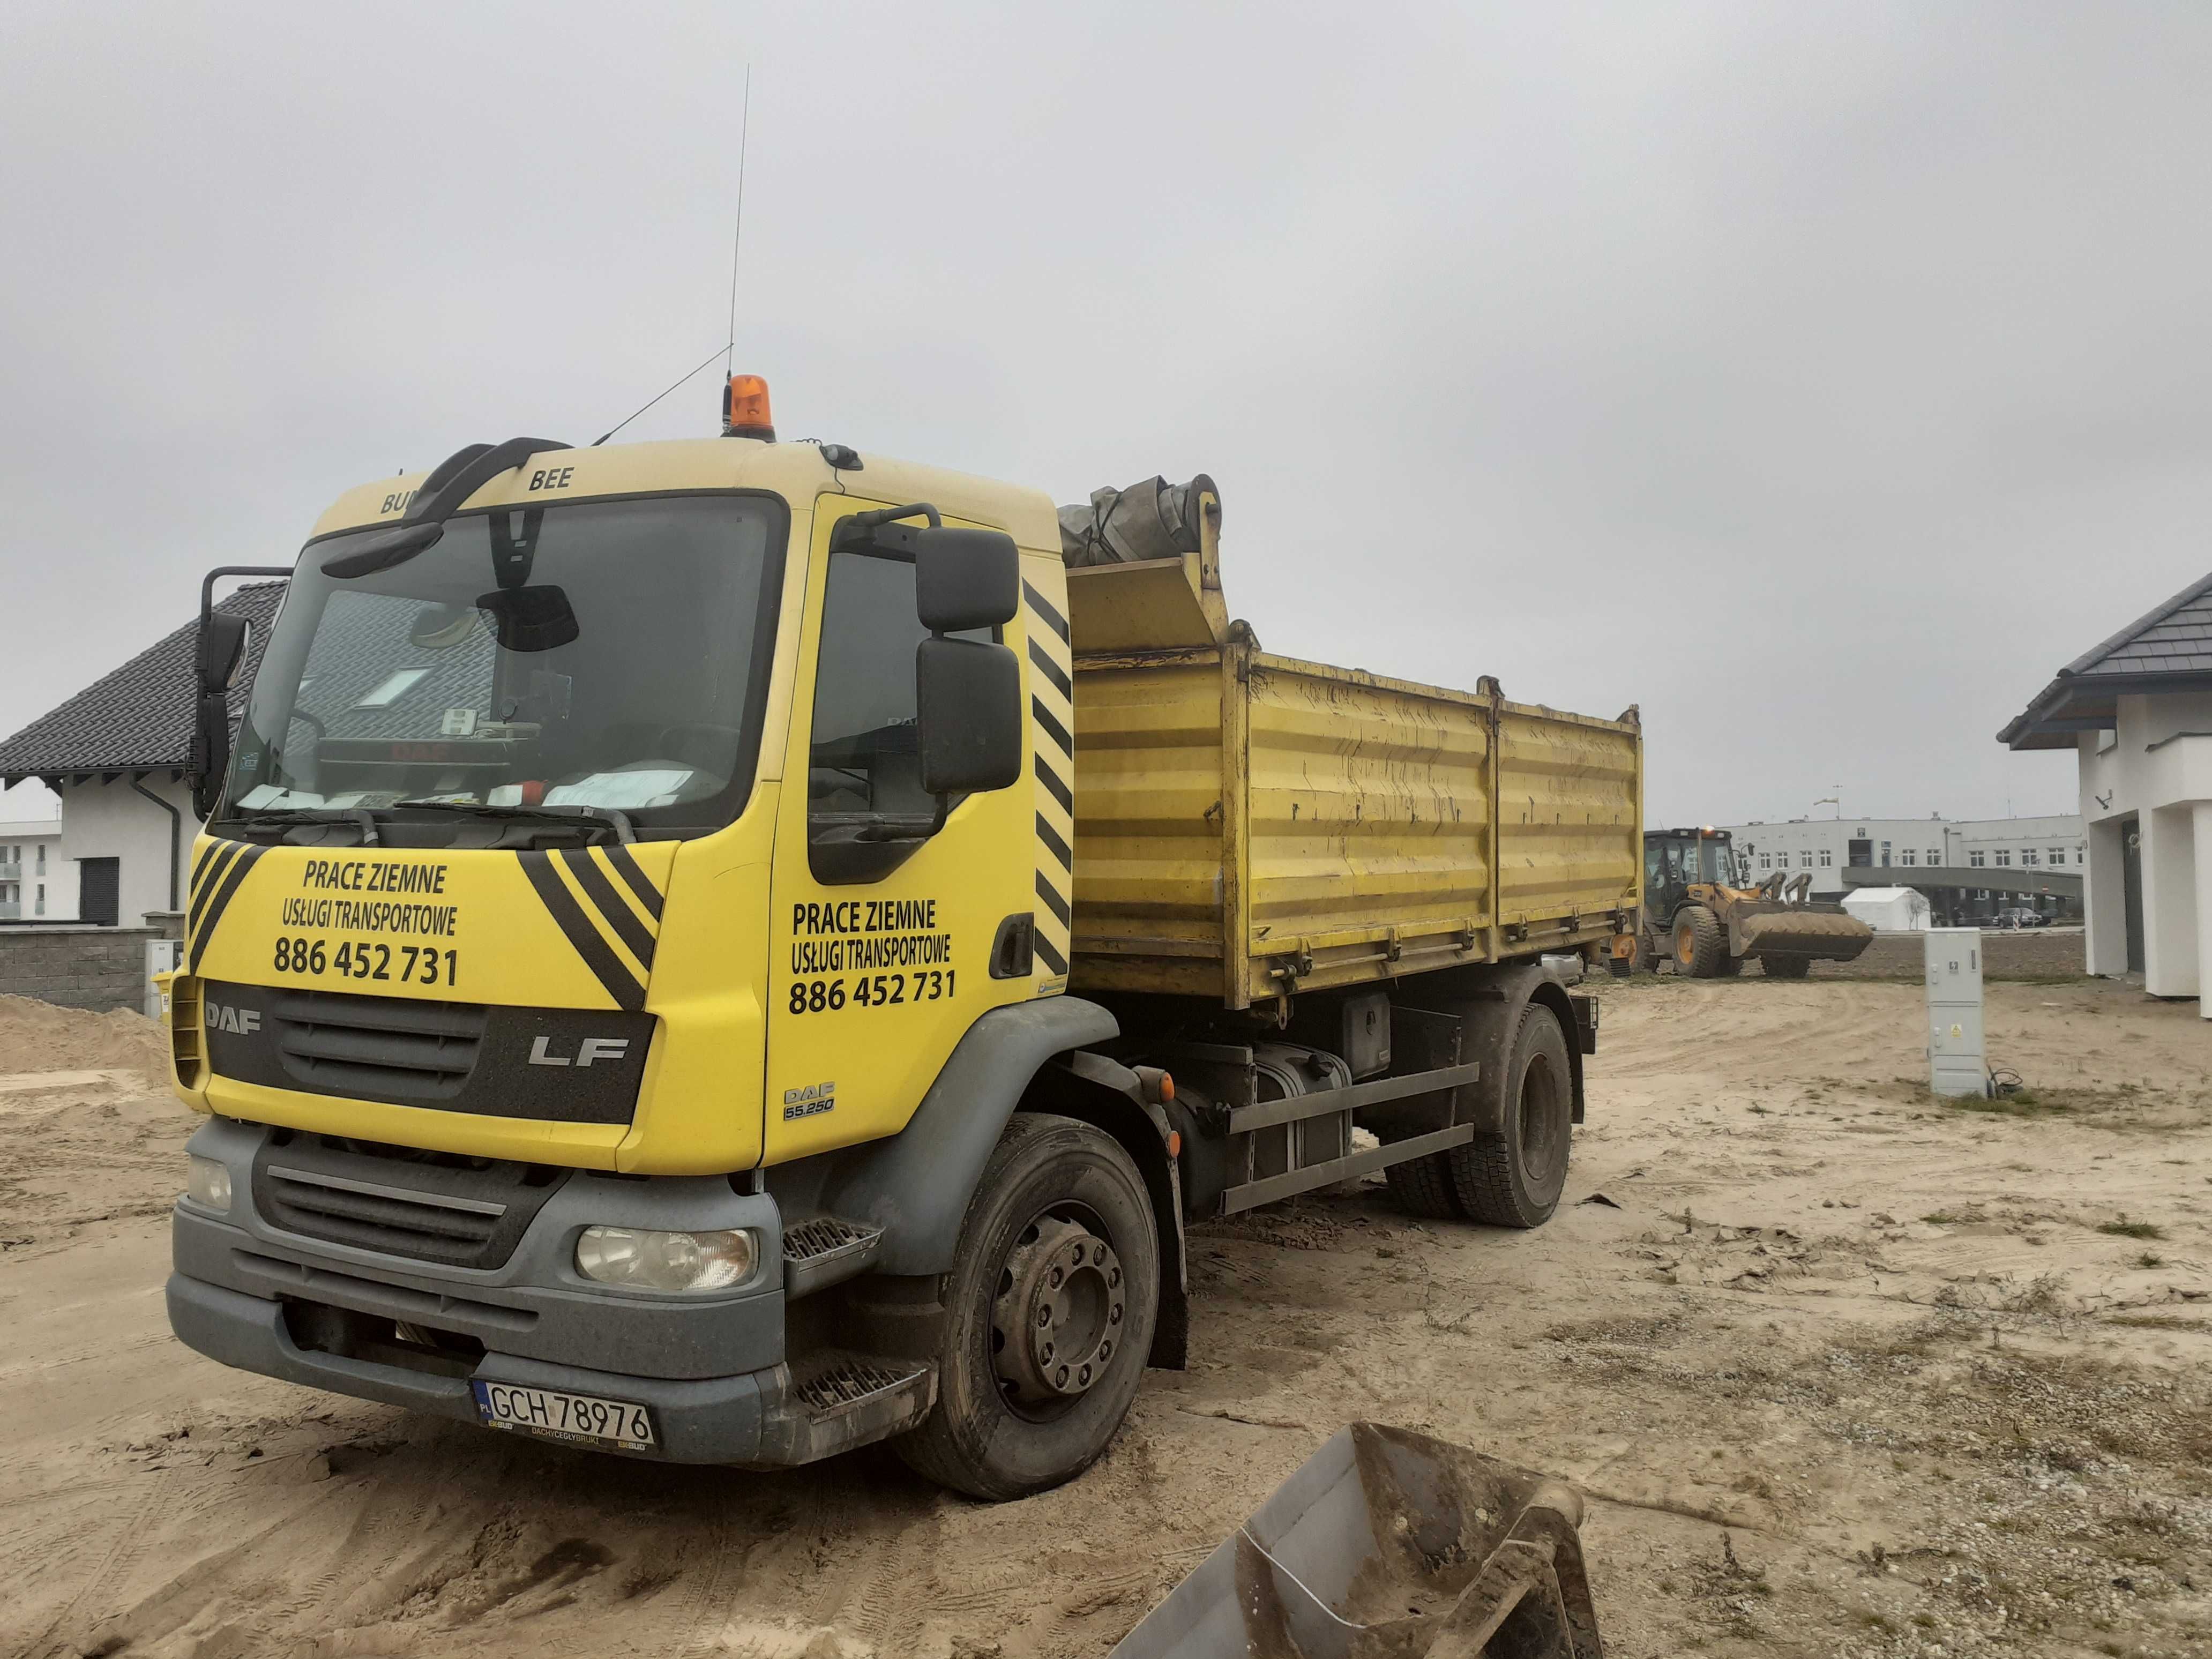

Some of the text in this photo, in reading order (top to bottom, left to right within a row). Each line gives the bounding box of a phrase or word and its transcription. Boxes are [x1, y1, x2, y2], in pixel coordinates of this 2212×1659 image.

[528, 467, 575, 491] BEE
[303, 860, 448, 894] PRACE ZIEMNE
[282, 898, 458, 936] USŁUGI TRANSPORTOWE
[793, 900, 936, 935] PRACE ZIEMNE
[274, 937, 458, 987] 886 452 731
[791, 934, 951, 975] USŁUGI TRANSPORTOWE
[789, 969, 955, 1015] 886 452 731
[205, 1001, 261, 1035] DAF
[528, 1036, 630, 1066] LF
[784, 1081, 836, 1104] DAF
[784, 1097, 835, 1119] 55.250
[480, 1403, 491, 1414] PL
[491, 1386, 649, 1440] GCH 78976
